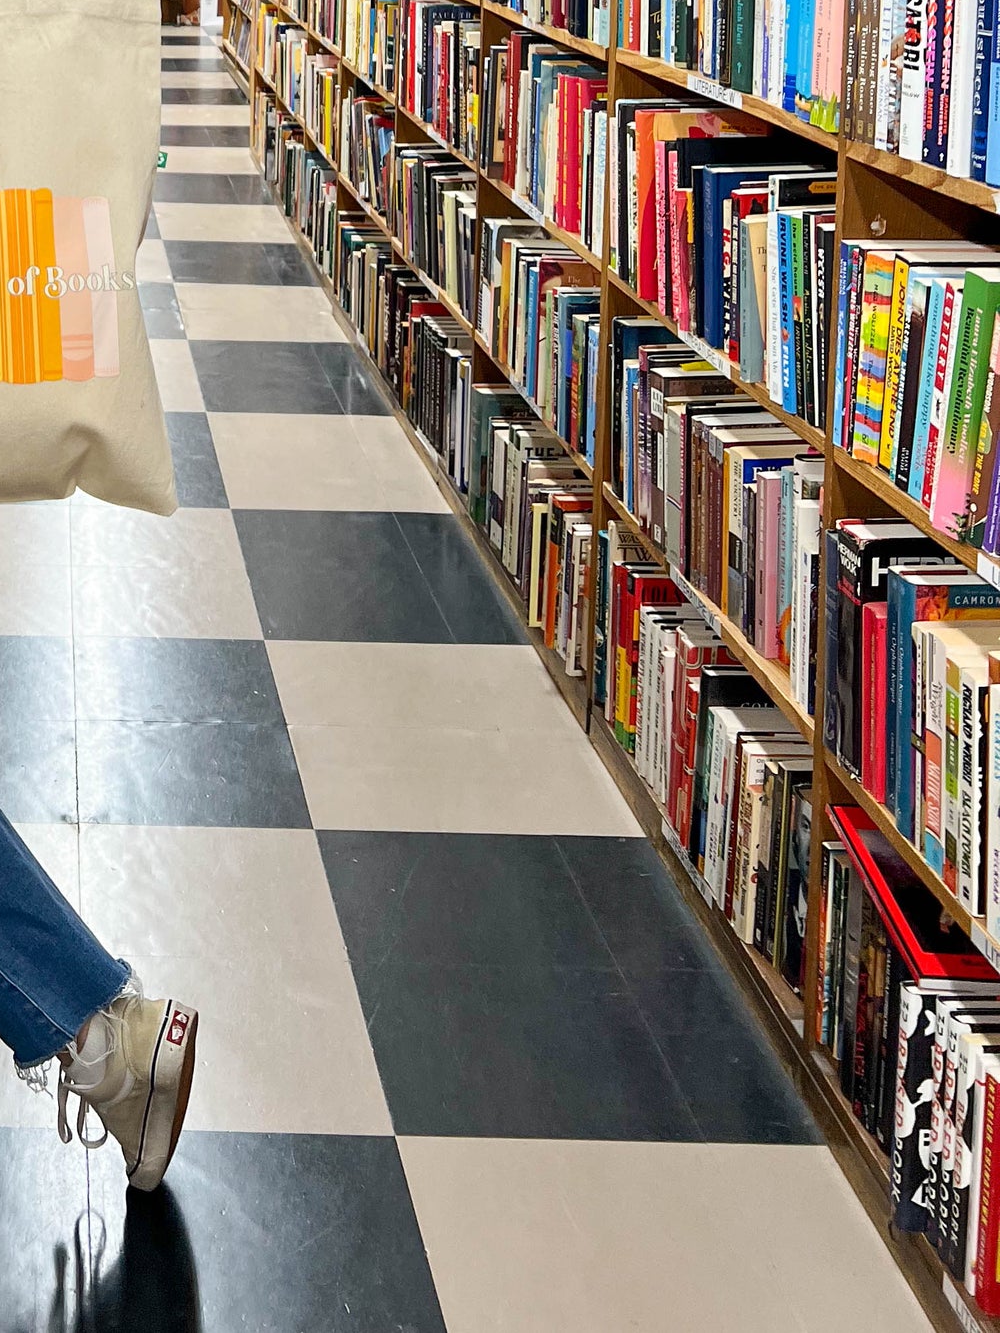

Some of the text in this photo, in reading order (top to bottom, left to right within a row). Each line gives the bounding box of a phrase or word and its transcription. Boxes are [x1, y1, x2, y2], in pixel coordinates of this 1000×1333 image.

[848, 24, 856, 74] Tending
[860, 24, 868, 74] Tending
[881, 5, 890, 46] LIFE
[870, 27, 878, 74] Tending
[694, 77, 736, 105] LITERATURE: W
[846, 75, 854, 111] Roses
[858, 77, 866, 113] Roses
[868, 77, 876, 115] Roses
[6, 266, 41, 296] of
[43, 263, 134, 299] Books
[898, 280, 906, 319] JOHN
[928, 292, 940, 358] something
[936, 291, 954, 384] LOTTERY
[895, 360, 900, 378] AT
[948, 306, 974, 455] Beautiful Revolutionary
[921, 388, 932, 431] happy
[984, 372, 995, 414] WOODSON
[962, 682, 973, 738] RICHARD
[960, 742, 972, 787] WRIGHT
[926, 758, 941, 831] NATIVE SON
[960, 832, 972, 879] POWER
[892, 1029, 907, 1204] BRAISED PORK
[926, 1042, 942, 1219] BRAISED PORK
[938, 1058, 954, 1239] BRAISED PORK
[980, 1073, 997, 1228] INTERIOR CHINATOWN
[950, 1099, 964, 1247] BRAISED PORK
